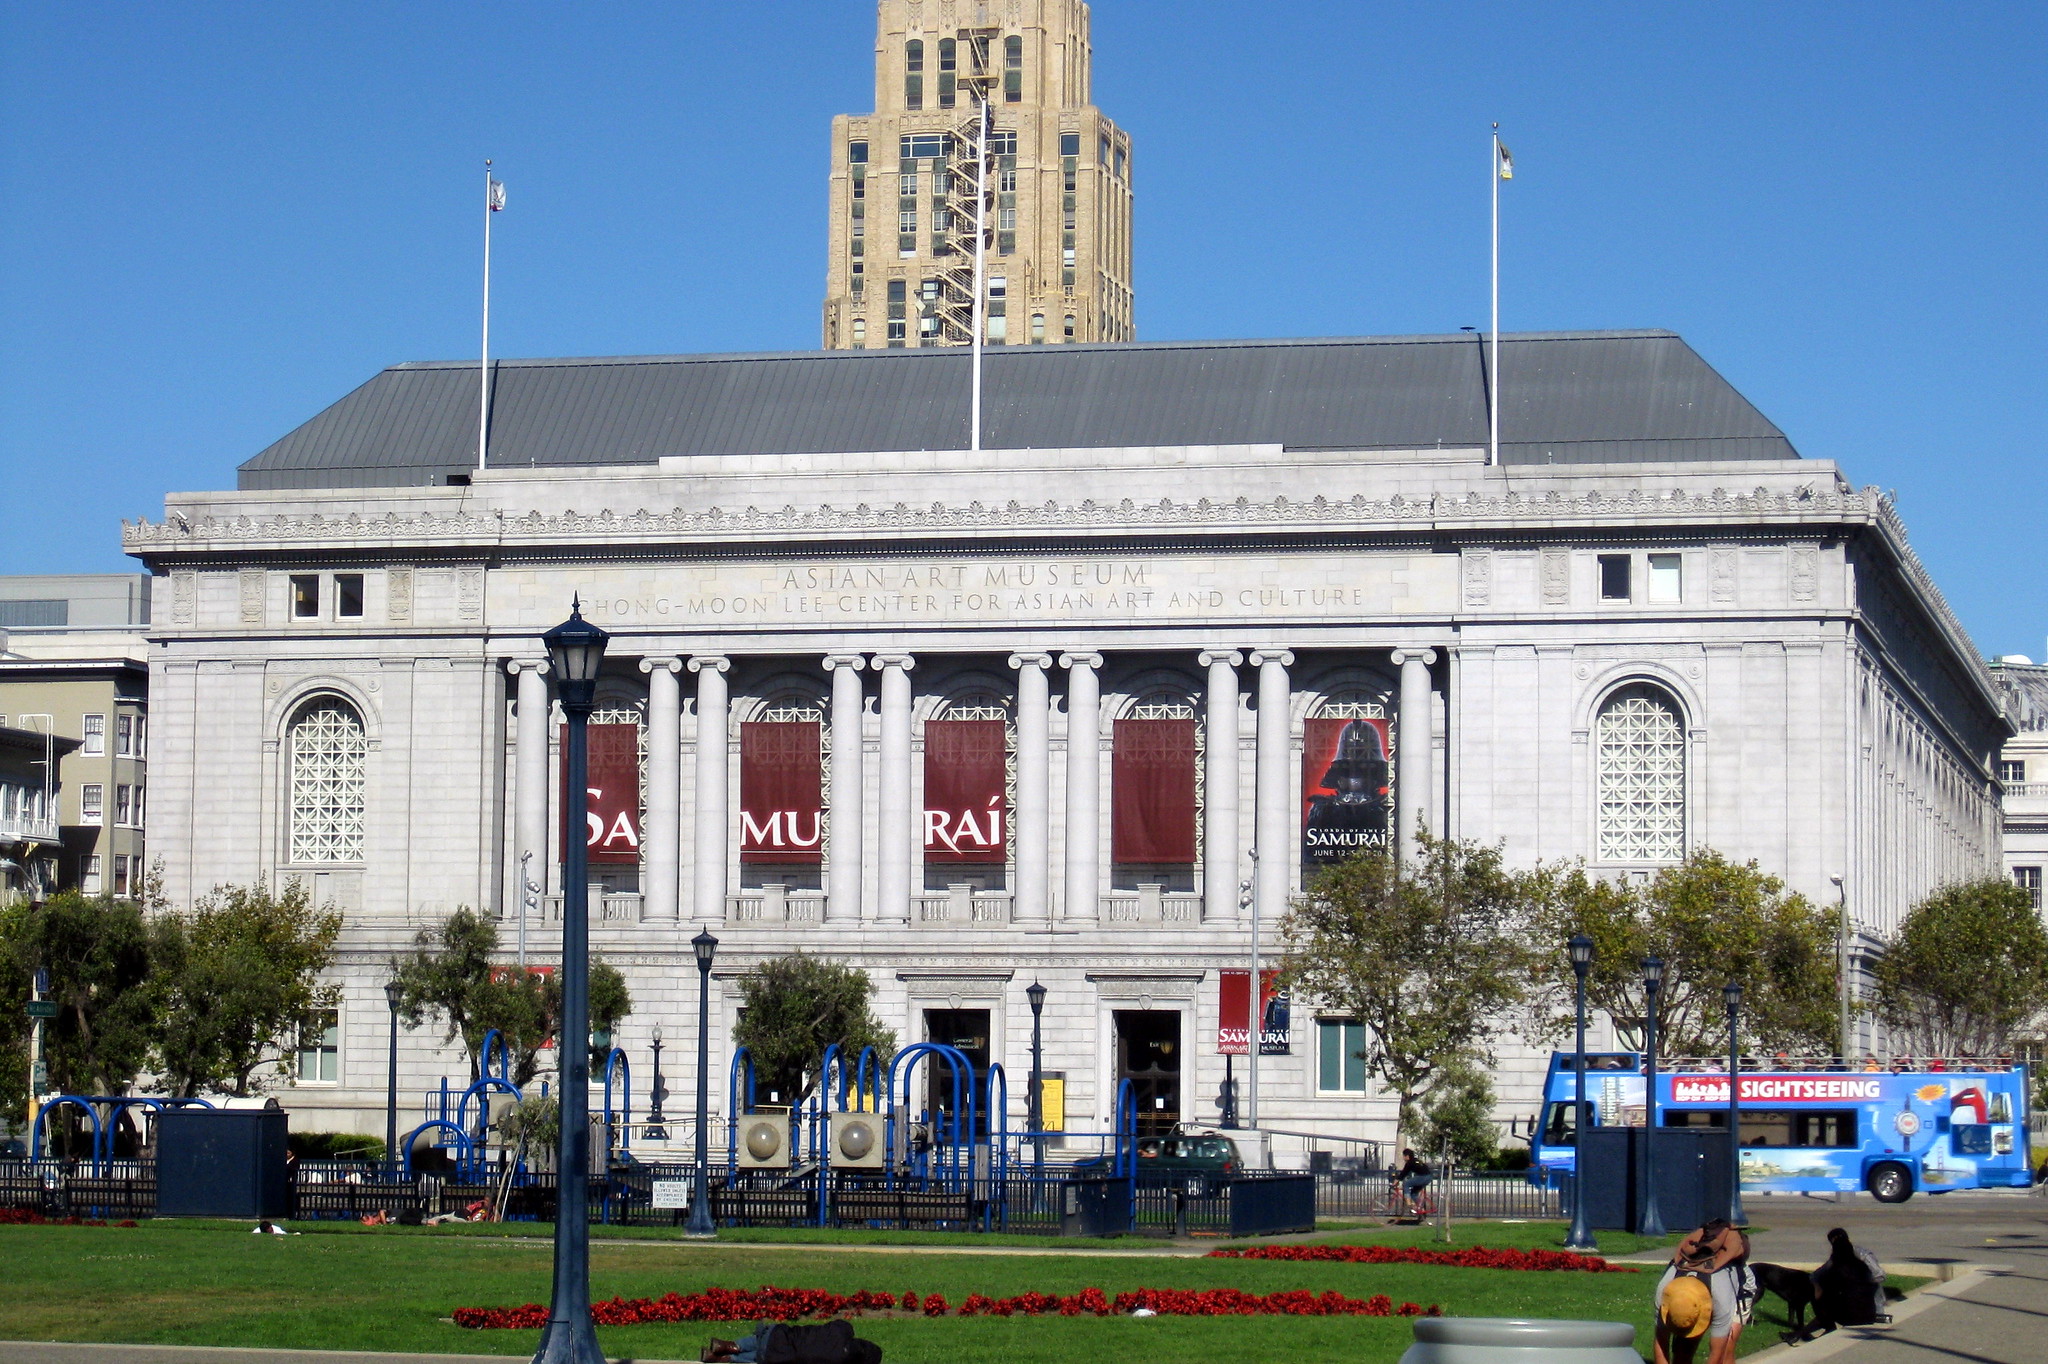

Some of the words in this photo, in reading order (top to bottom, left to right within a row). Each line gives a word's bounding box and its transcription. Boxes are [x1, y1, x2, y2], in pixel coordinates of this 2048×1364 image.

[783, 567, 886, 590] ASIAN
[903, 566, 969, 589] ART
[984, 563, 1147, 587] MUSEUM
[577, 597, 768, 616] CHONG-MOON
[783, 595, 823, 613] LEE
[838, 594, 939, 613] CENTER
[952, 593, 1000, 612] FOR
[1014, 591, 1095, 610] ASIAN
[1107, 590, 1155, 609] ART
[1168, 589, 1224, 608] AND
[1238, 588, 1363, 607] CULTURE
[740, 810, 821, 847] MU
[1313, 849, 1334, 857] JUNE
[1740, 1080, 1881, 1099] SIGHTSEEING
